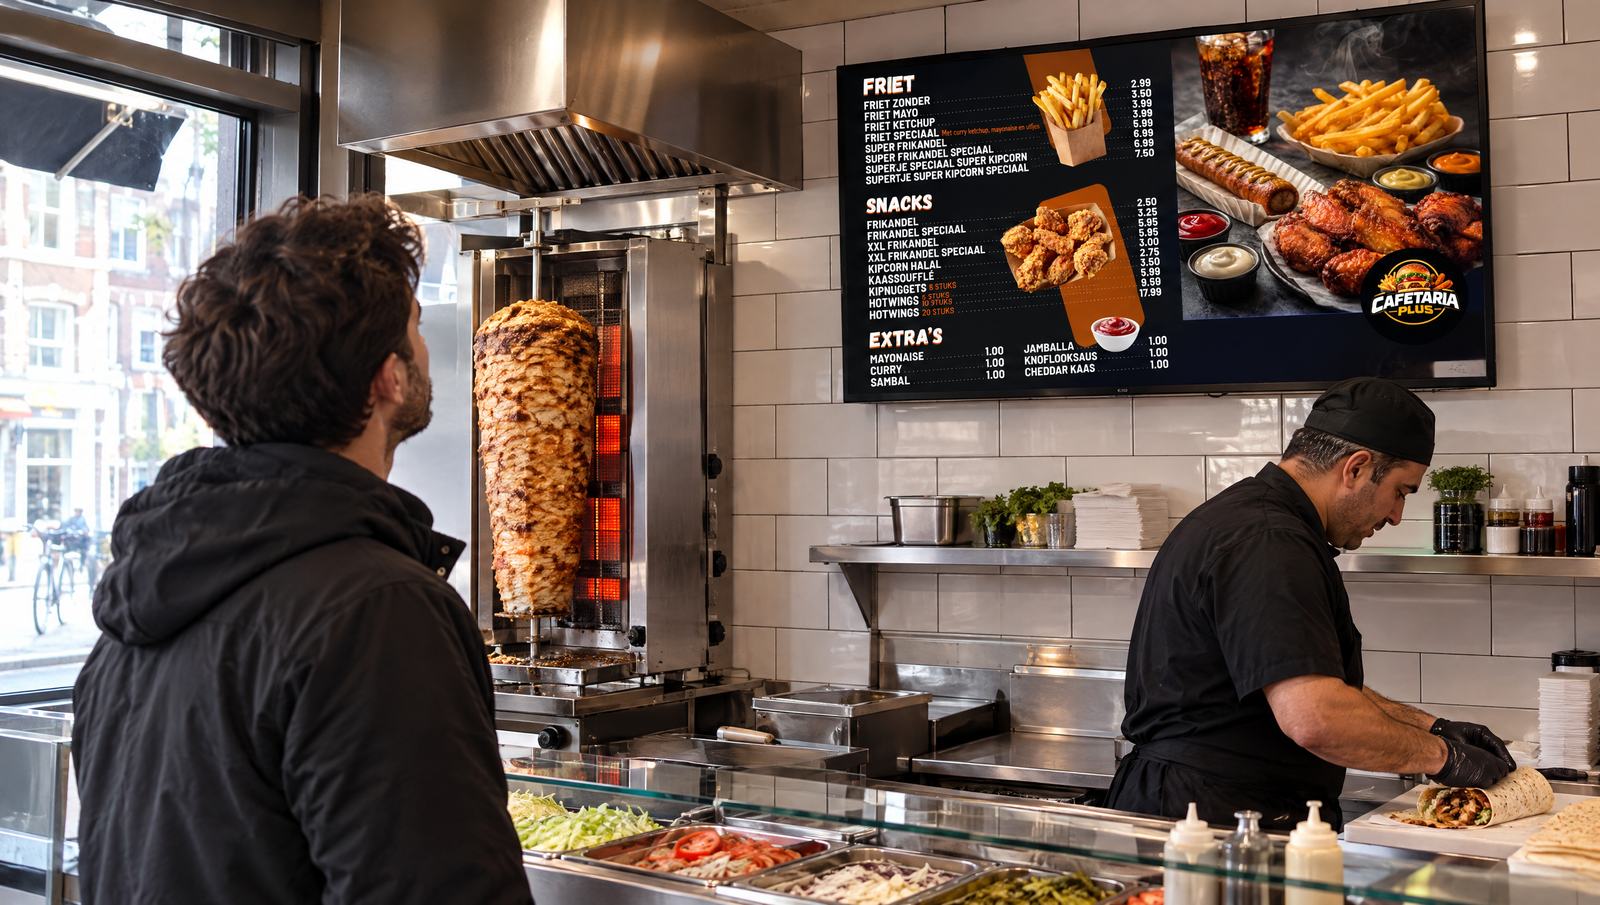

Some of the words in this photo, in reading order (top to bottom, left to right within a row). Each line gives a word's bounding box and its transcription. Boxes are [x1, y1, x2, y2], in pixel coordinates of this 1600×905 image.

[864, 75, 914, 96] FRIET
[1131, 78, 1151, 88] 2.99
[1132, 89, 1151, 98] 3.50
[864, 100, 890, 110] FRIET
[893, 96, 930, 108] ZONDER
[1132, 99, 1152, 108] 3.99
[864, 111, 890, 121] FRIET
[893, 108, 918, 118] MAYO
[1133, 109, 1152, 118] 3.99
[865, 122, 890, 132] FRIET
[893, 118, 935, 129] KETCHUP
[1133, 118, 1153, 128] 5.99
[865, 132, 891, 142] FRIET
[894, 129, 939, 140] SPECIAAL
[1134, 128, 1153, 138] 6.99
[865, 143, 895, 153] SUPER
[897, 139, 947, 150] FRIKANDEL
[1134, 138, 1154, 148] 6.99
[866, 154, 895, 163] SUPER
[898, 149, 948, 161] FRIKANDEL
[951, 145, 994, 156] SPECIAAL
[1135, 148, 1154, 158] 7.50
[910, 159, 955, 170] SPECIAAL
[957, 156, 986, 167] SUPER
[989, 152, 1027, 164] KIPCORN
[866, 173, 911, 184] SUPERTJE
[914, 171, 942, 181] SUPER
[946, 167, 984, 179] KIPCORN
[986, 163, 1029, 175] SPECIAAL
[866, 194, 932, 214] SNACKS
[1137, 198, 1156, 206] 2.50
[1138, 208, 1157, 217] 3.25
[867, 218, 918, 229] FRIKANDEL
[1138, 218, 1158, 227] 5.95
[867, 228, 919, 240] FRIKANDEL
[922, 225, 966, 236] SPECIAAL
[1139, 228, 1158, 237] 5.95
[868, 242, 885, 251] XXL
[888, 238, 939, 250] FRIKANDEL
[1139, 238, 1159, 246] 3.00
[868, 253, 885, 262] XXL
[888, 249, 939, 261] FRIKANDEL
[942, 246, 985, 257] SPECIAAL
[1140, 248, 1159, 256] 2.75
[868, 262, 908, 273] KIPCORN
[911, 260, 941, 270] HALAL
[1141, 257, 1160, 266] 3.50
[869, 270, 934, 285] KAASSOUFFLÉ
[1141, 267, 1160, 276] 5.99
[869, 284, 926, 296] KIPNUGGETS
[935, 282, 956, 290] STUKS
[1140, 288, 1162, 297] 17.99
[869, 296, 919, 308] HOTWINGS
[1371, 292, 1459, 314] CAFETARIA
[869, 308, 919, 320] HOTWINGS
[933, 307, 954, 315] STUKS
[1398, 305, 1434, 316] PLUS
[1024, 342, 1074, 353] JAMBALLA
[1148, 336, 1167, 345] 1.00
[870, 352, 924, 364] MAYONAISE
[985, 346, 1004, 356] 1.00
[1024, 352, 1097, 365] KNOFLOOKSAUS
[1149, 348, 1168, 357] 1.00
[870, 365, 902, 375] CURRY
[986, 358, 1004, 368] 1.00
[1025, 366, 1068, 376] CHEDDAR
[1070, 364, 1096, 374] KAAS
[1150, 359, 1169, 369] 1.00
[871, 376, 910, 387] SAMBAL
[986, 370, 1005, 380] 1.00
